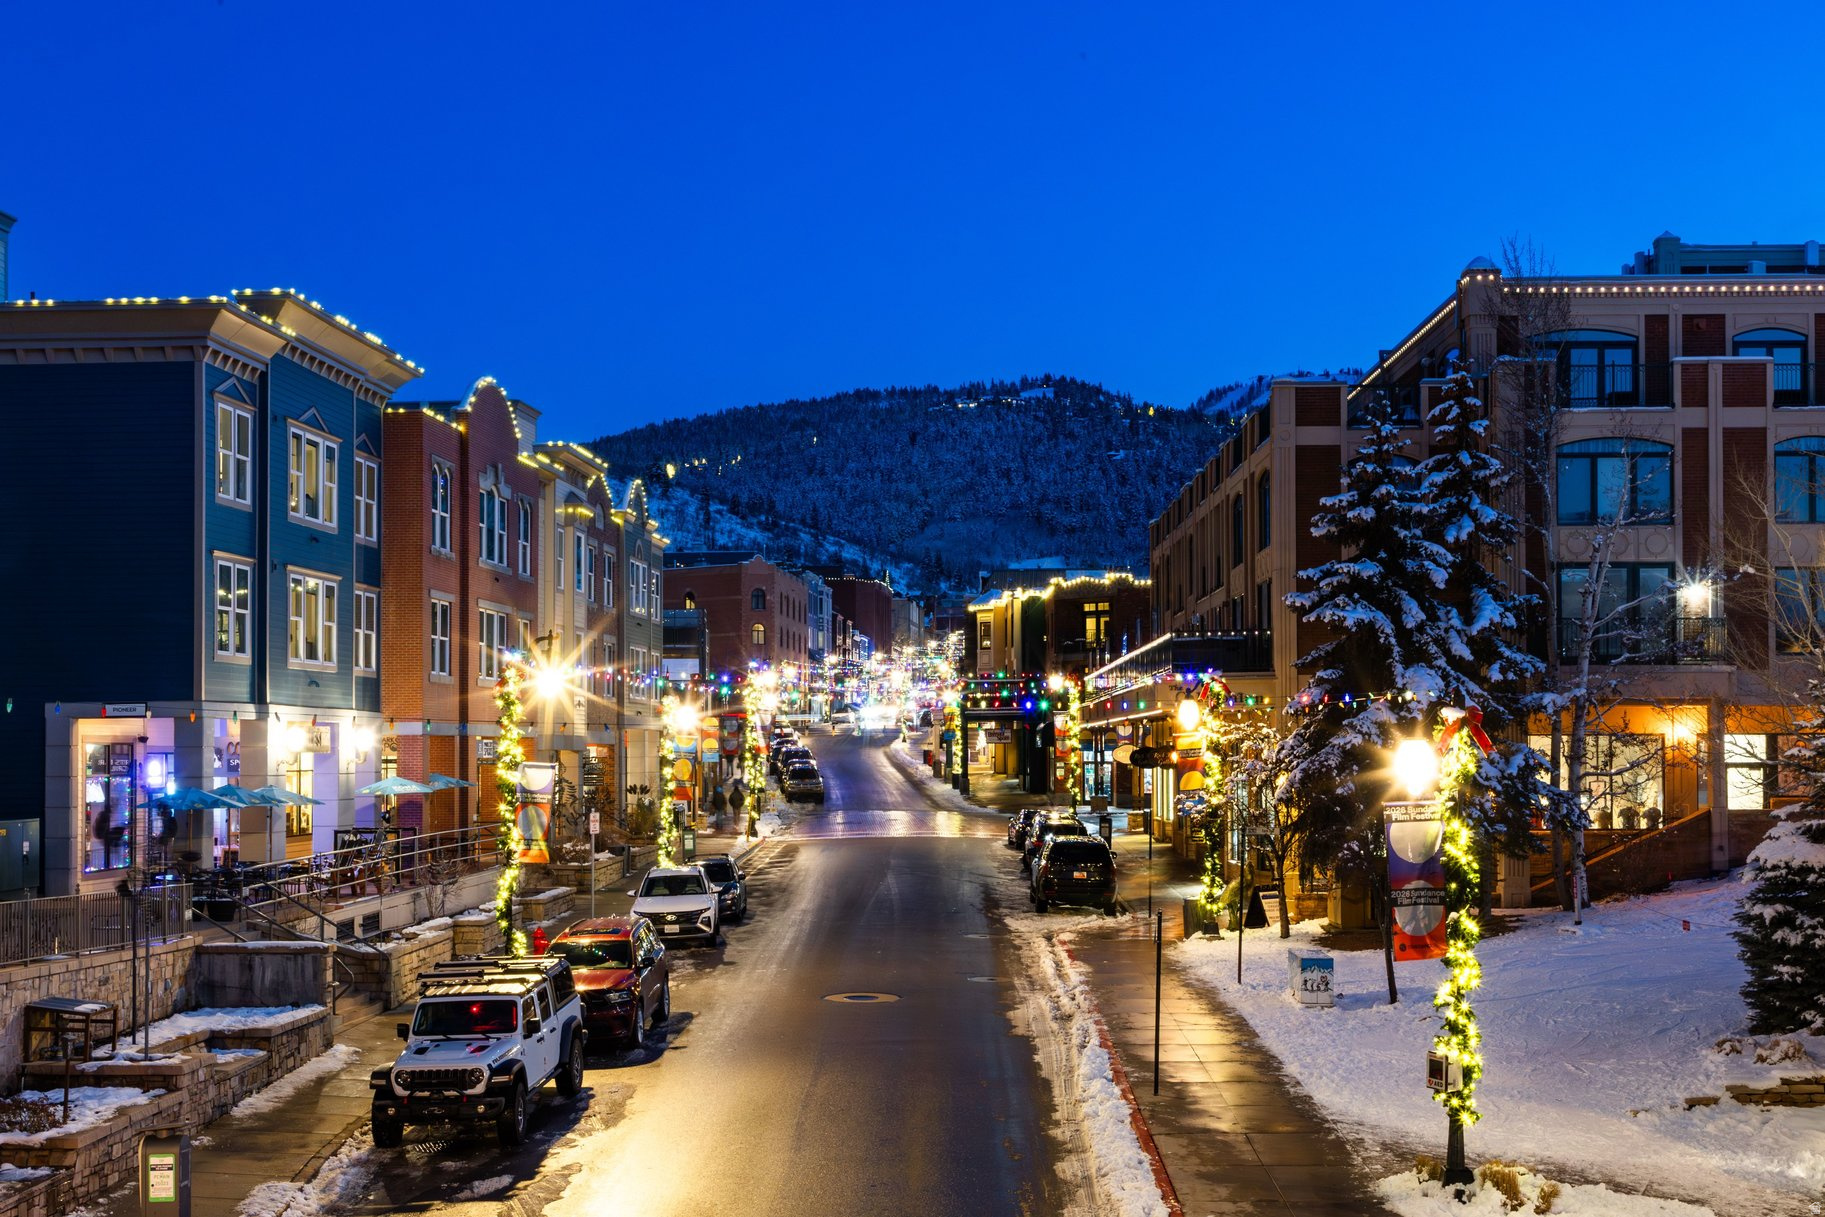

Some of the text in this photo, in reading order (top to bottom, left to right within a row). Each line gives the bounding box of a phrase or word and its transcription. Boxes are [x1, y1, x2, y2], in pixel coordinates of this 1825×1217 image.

[1391, 890, 1410, 898] 2026
[1397, 896, 1440, 905] Film Festival
[1434, 1079, 1443, 1088] AED
